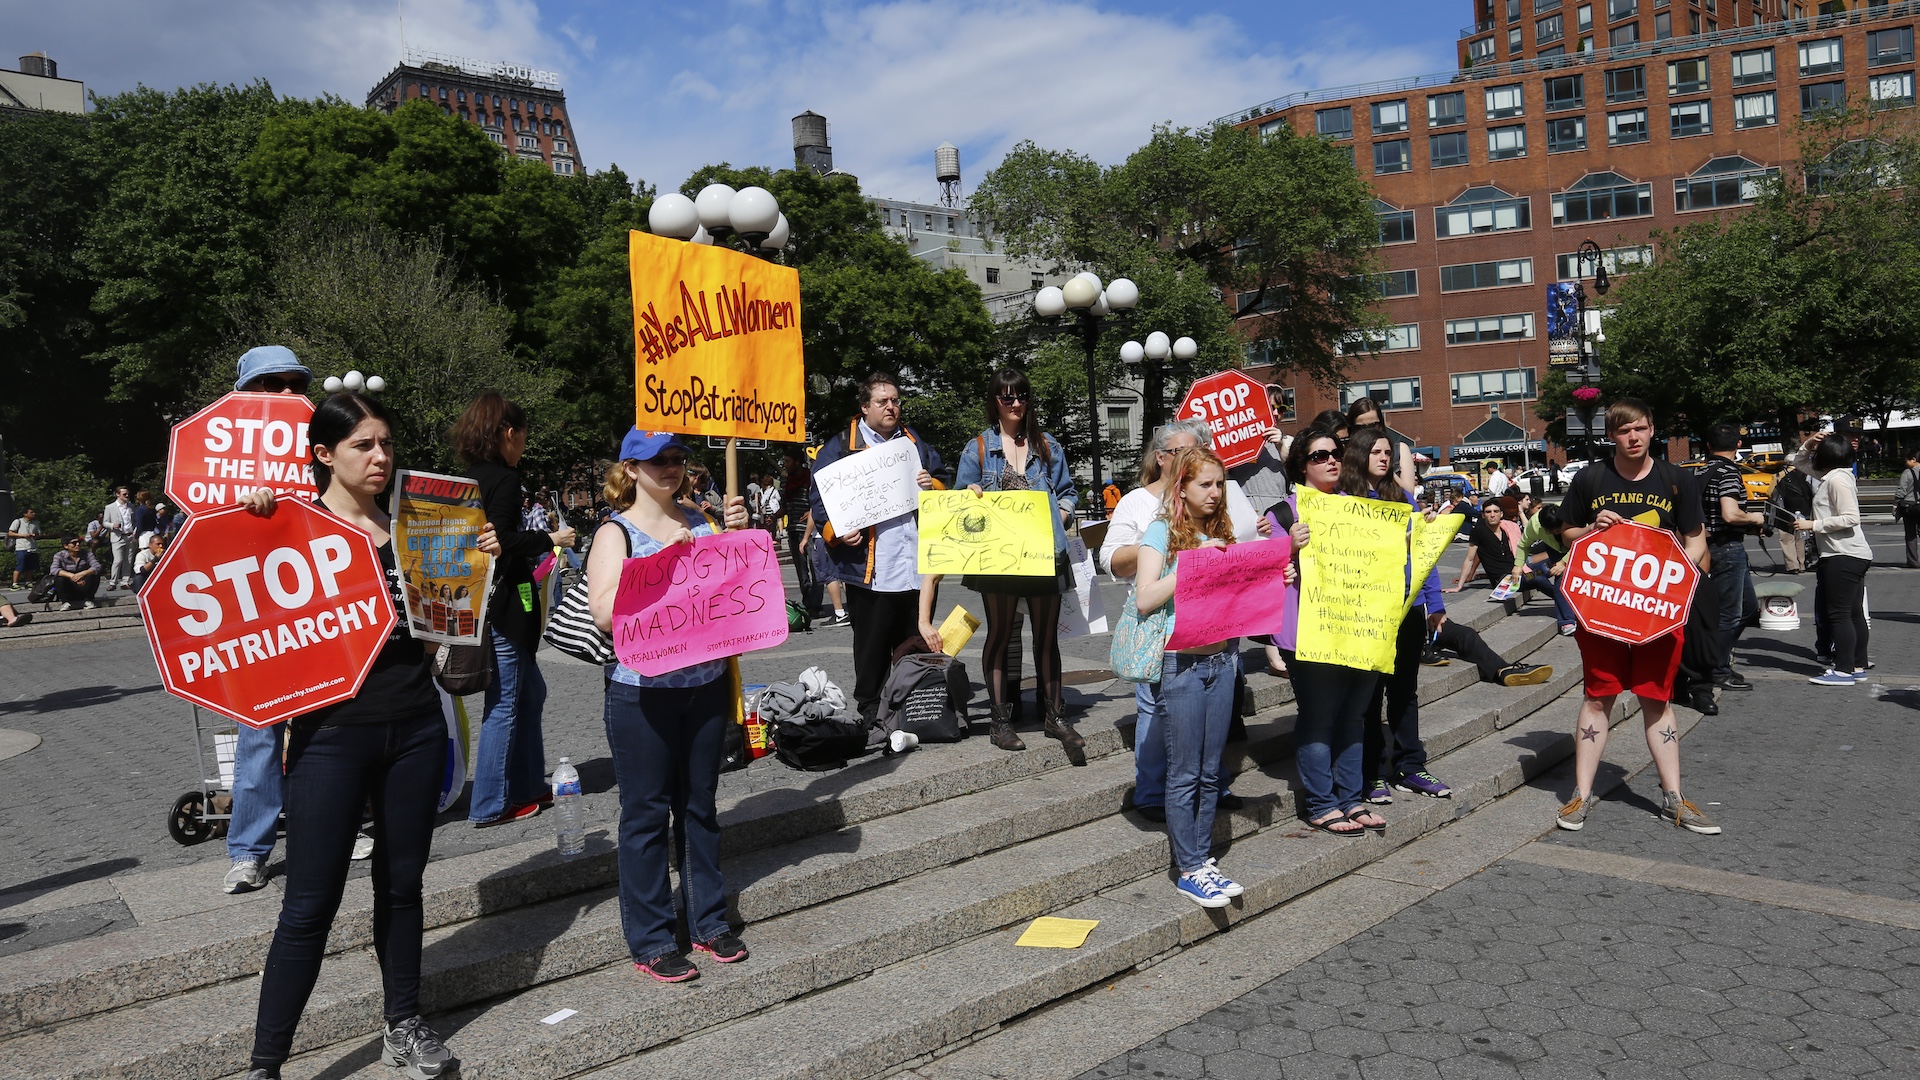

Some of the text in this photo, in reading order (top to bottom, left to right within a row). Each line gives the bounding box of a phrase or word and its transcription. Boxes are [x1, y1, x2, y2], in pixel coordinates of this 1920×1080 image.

[496, 62, 559, 85] SQUARE
[644, 374, 797, 435] StopPatriarchy.org
[1189, 382, 1250, 421] STOP
[1206, 407, 1257, 433] HE WAR
[1217, 420, 1266, 449] WOMEN
[1459, 442, 1539, 455] STARBUCKS COFEE
[204, 457, 316, 486] THE WAR
[187, 482, 226, 505] ON
[840, 478, 901, 512] ENTITLEMENT
[852, 476, 876, 493] MALE
[863, 495, 888, 512] KILLS
[921, 491, 1036, 517] OPEN YOUR
[1591, 492, 1674, 513] WU-TANG CLAN
[407, 517, 467, 527] Abortion Rights
[407, 526, 440, 535] Freedom
[442, 525, 460, 533] Ride
[407, 533, 479, 551] GROUND
[422, 548, 465, 565] ZERO
[622, 536, 771, 597] MISOGYNY
[926, 541, 1026, 572] EYES!
[1188, 550, 1276, 572] #YesAllWomen
[1582, 541, 1686, 594] STOP
[419, 562, 471, 579] TEXAS
[171, 534, 353, 637] STOP
[687, 584, 701, 599] IS
[1308, 586, 1342, 604] Women
[1569, 576, 1682, 620] PATRIARCHY
[622, 579, 768, 647] MADNESS
[178, 596, 378, 684] PATRIARCHY
[622, 642, 688, 666] #YESALLWOMEN
[253, 676, 346, 712] stoppatriarchy.tumblr.com
